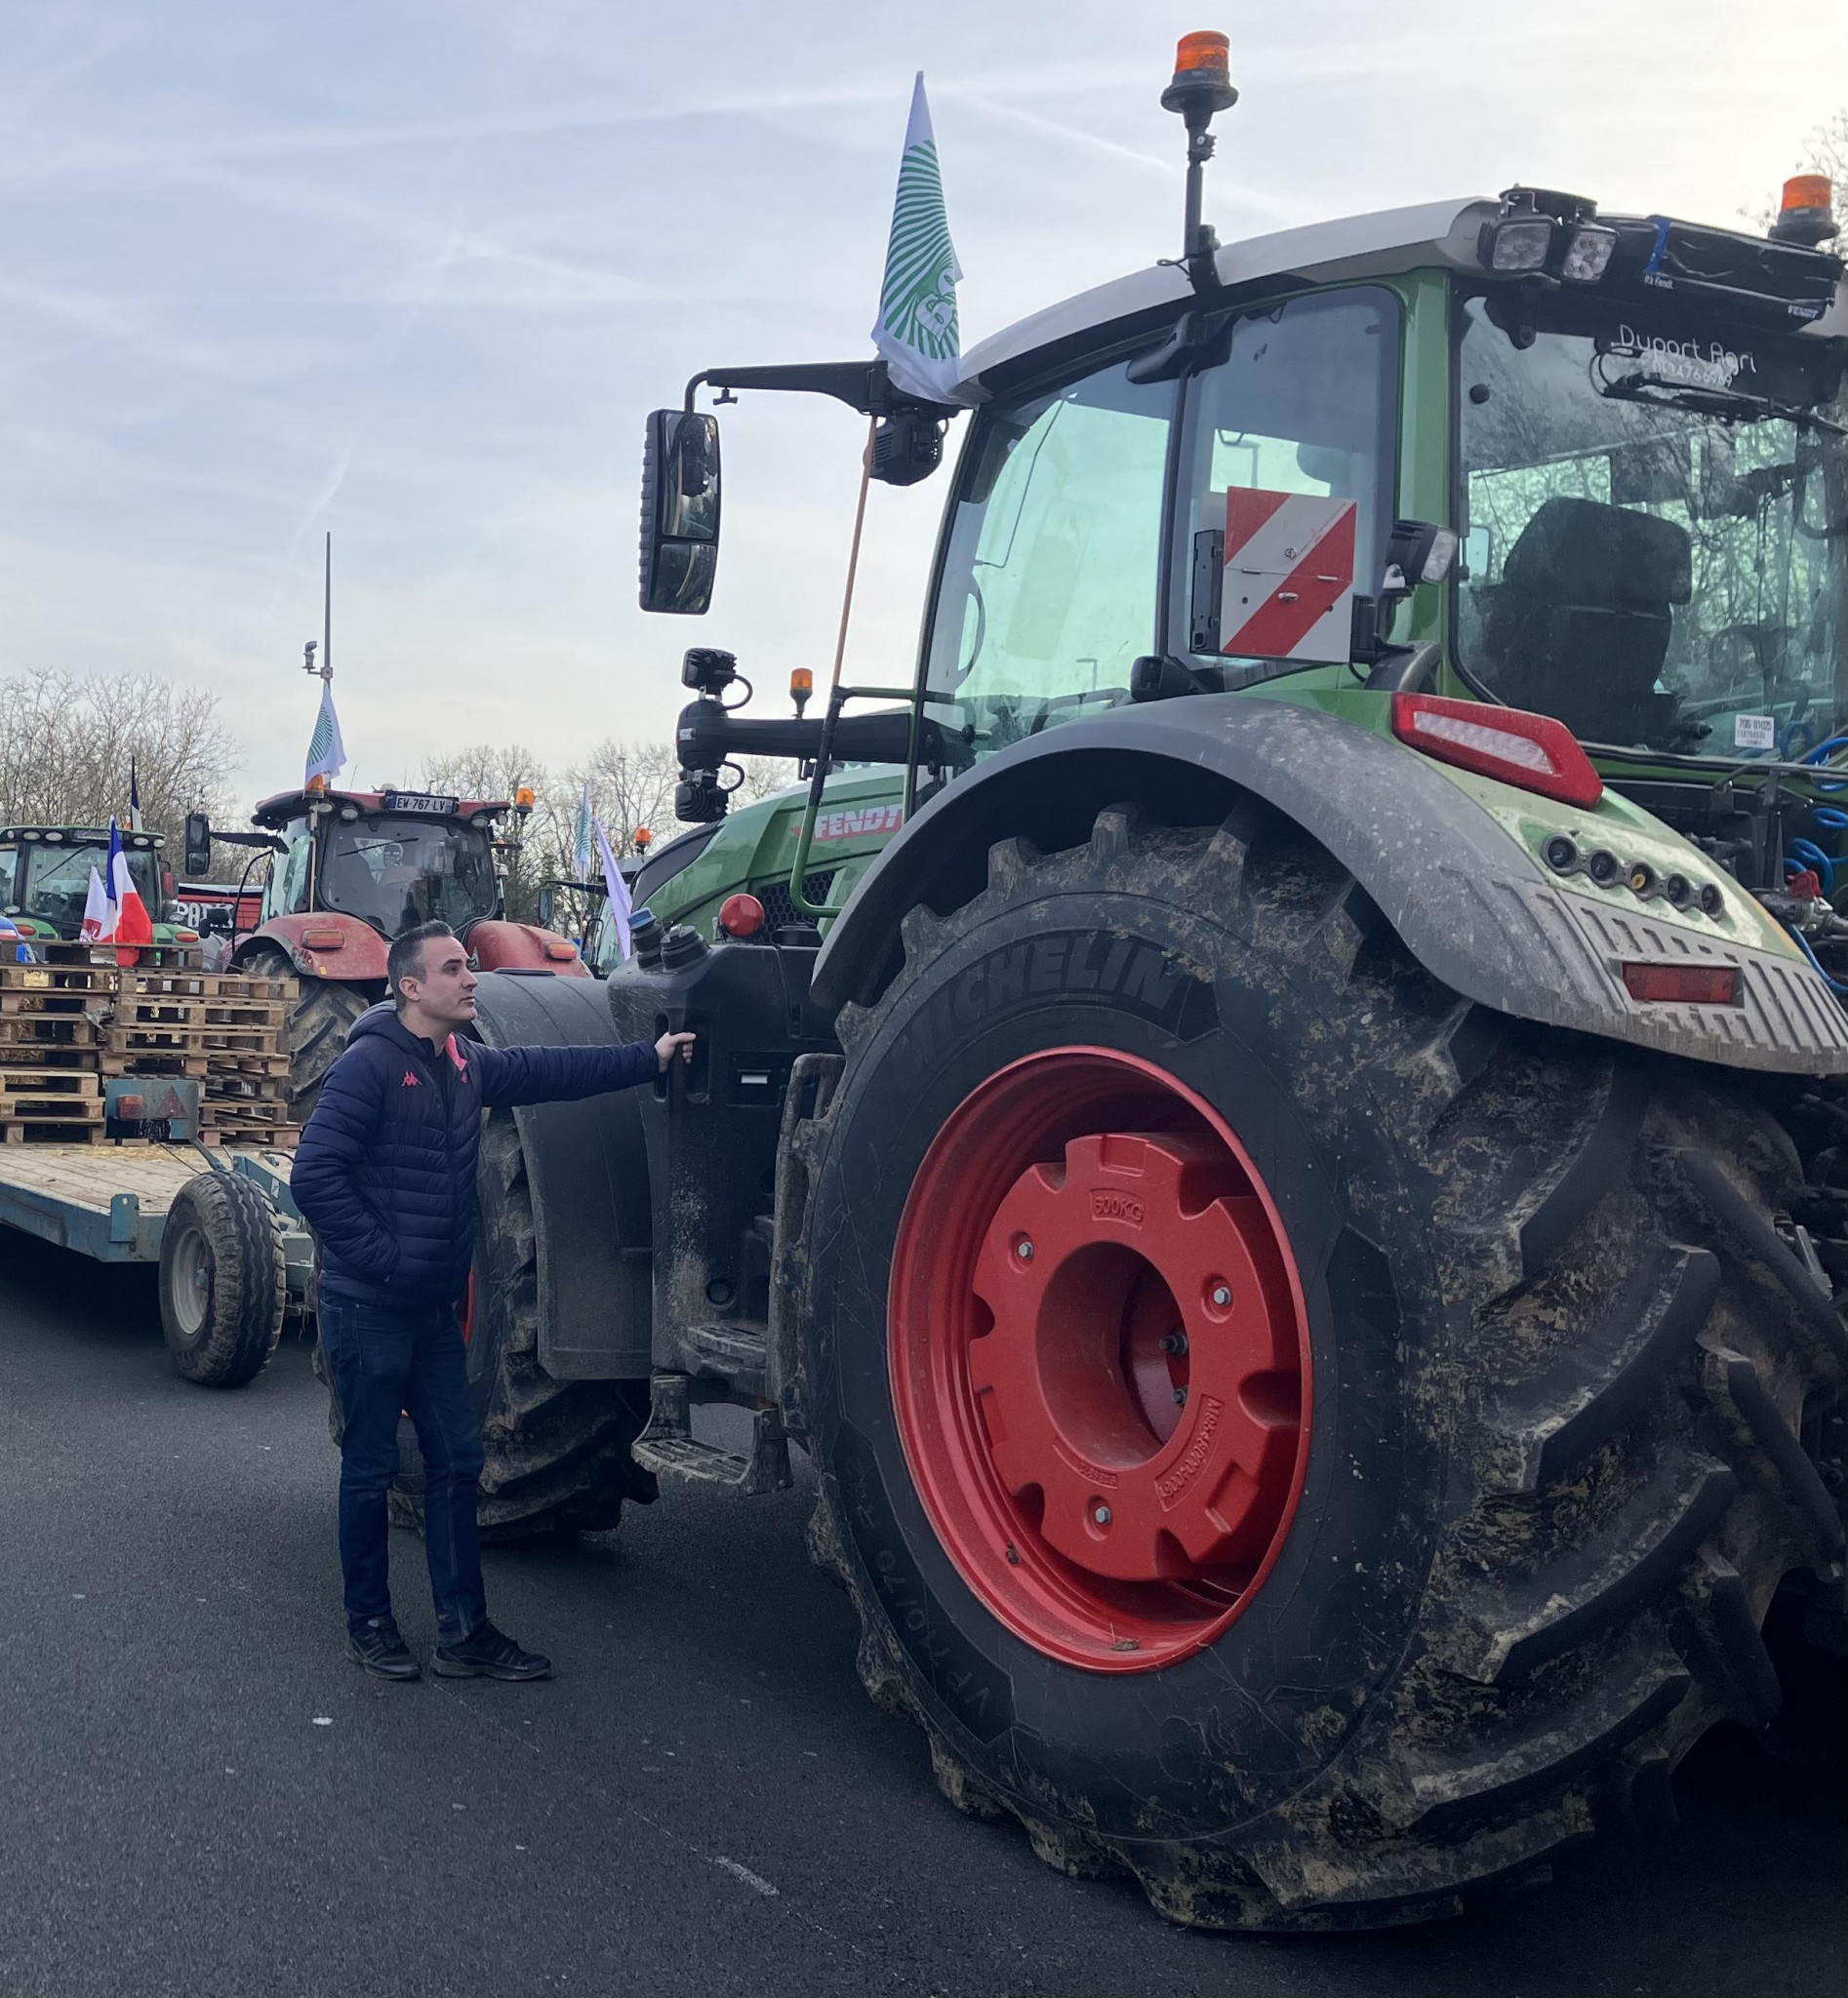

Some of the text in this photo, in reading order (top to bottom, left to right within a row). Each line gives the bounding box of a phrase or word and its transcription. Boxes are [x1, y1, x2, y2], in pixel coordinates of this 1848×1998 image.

[1620, 324, 1757, 377] Duport Agri
[814, 803, 904, 839] FENDT
[891, 933, 1185, 1081] MICHELIN
